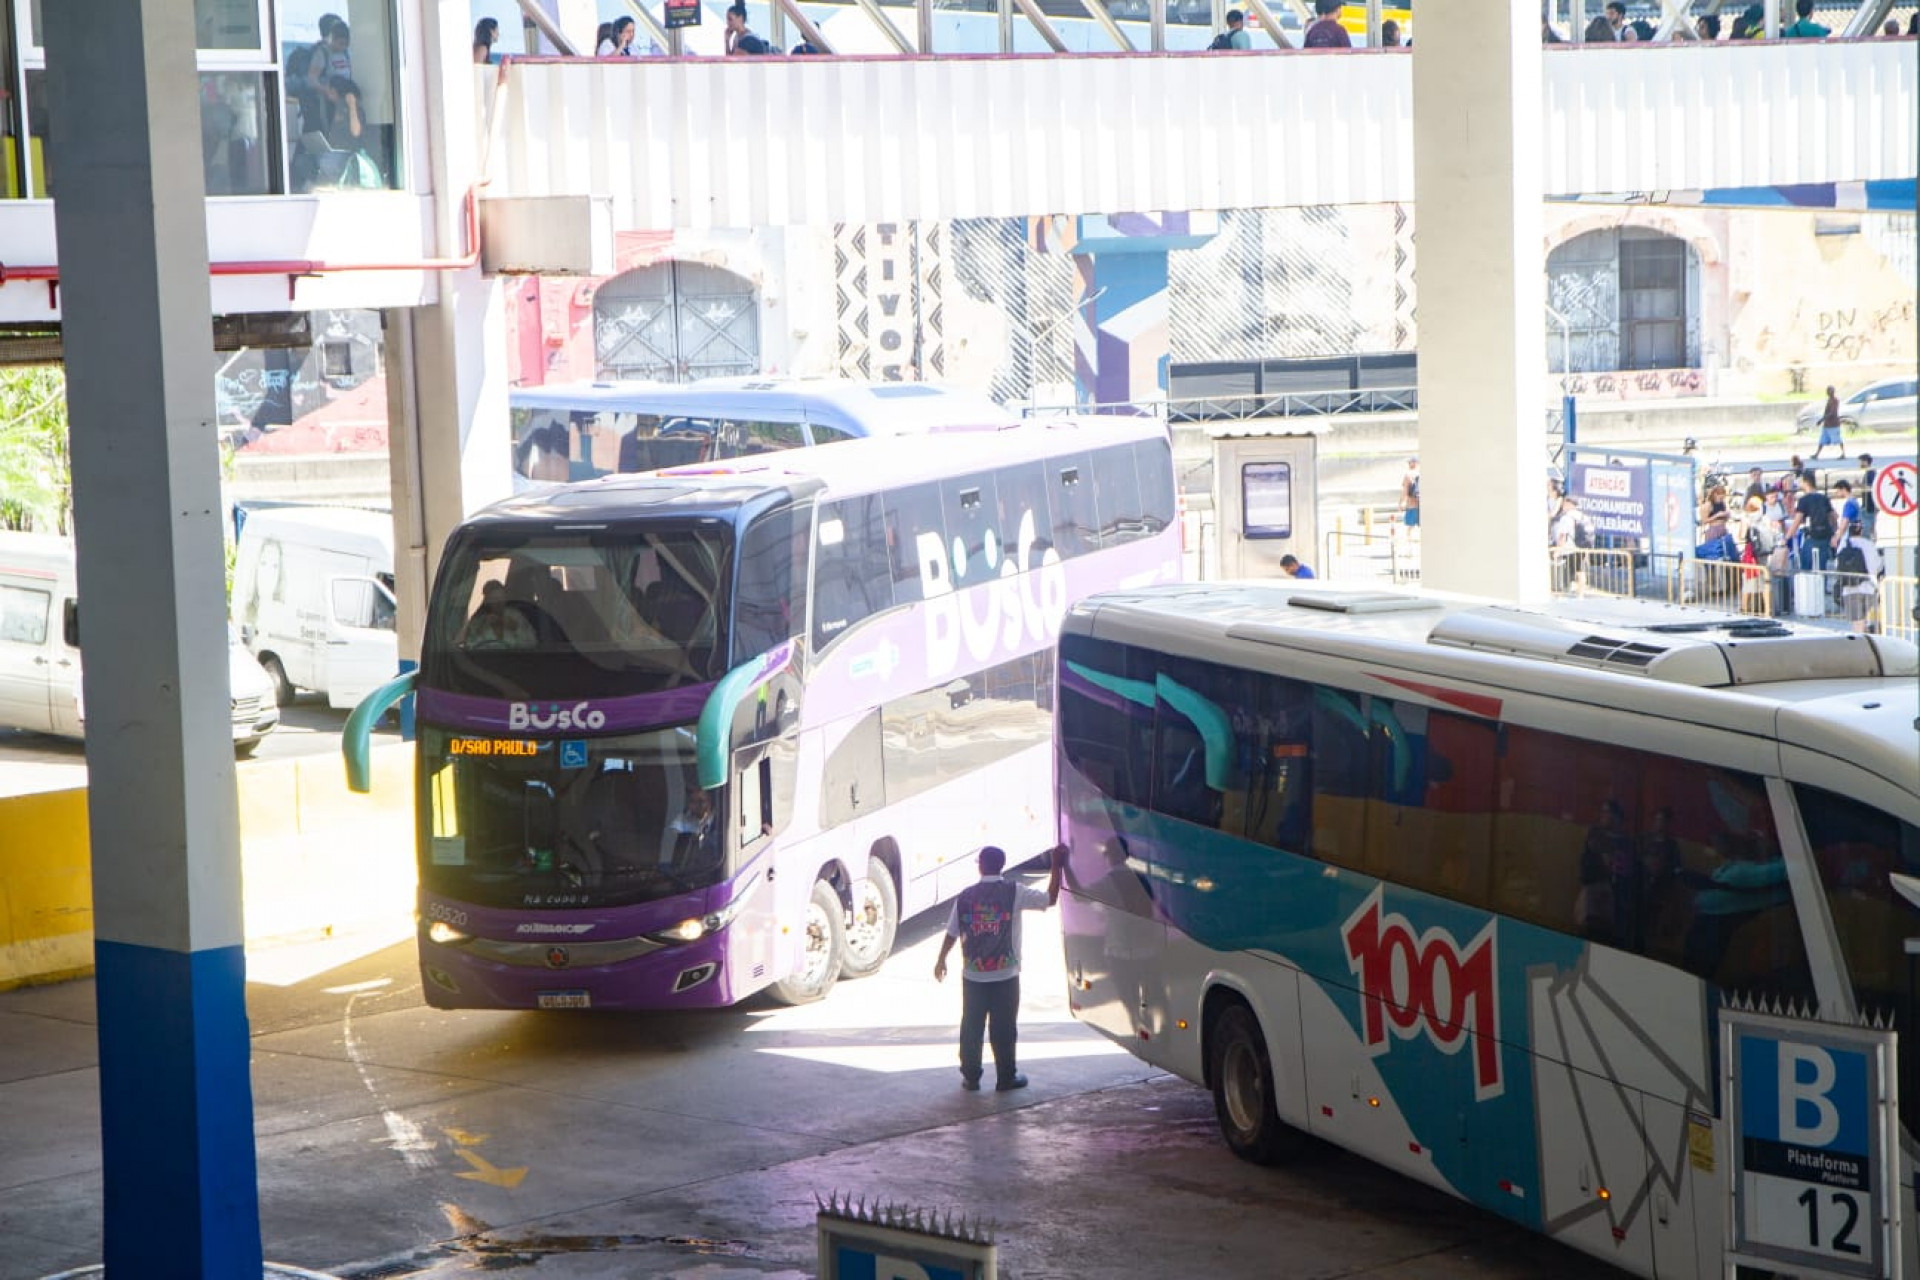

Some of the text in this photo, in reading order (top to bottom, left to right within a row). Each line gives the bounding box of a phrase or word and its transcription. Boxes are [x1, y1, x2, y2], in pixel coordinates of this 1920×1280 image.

[1577, 498, 1643, 516] STACIONAMENTO
[494, 740, 537, 755] PAULO
[1341, 881, 1504, 1102] 1001
[1777, 1040, 1840, 1148] B
[1787, 1149, 1859, 1174] Plataforma
[1822, 1171, 1859, 1186] Platform
[1798, 1187, 1861, 1255] 12
